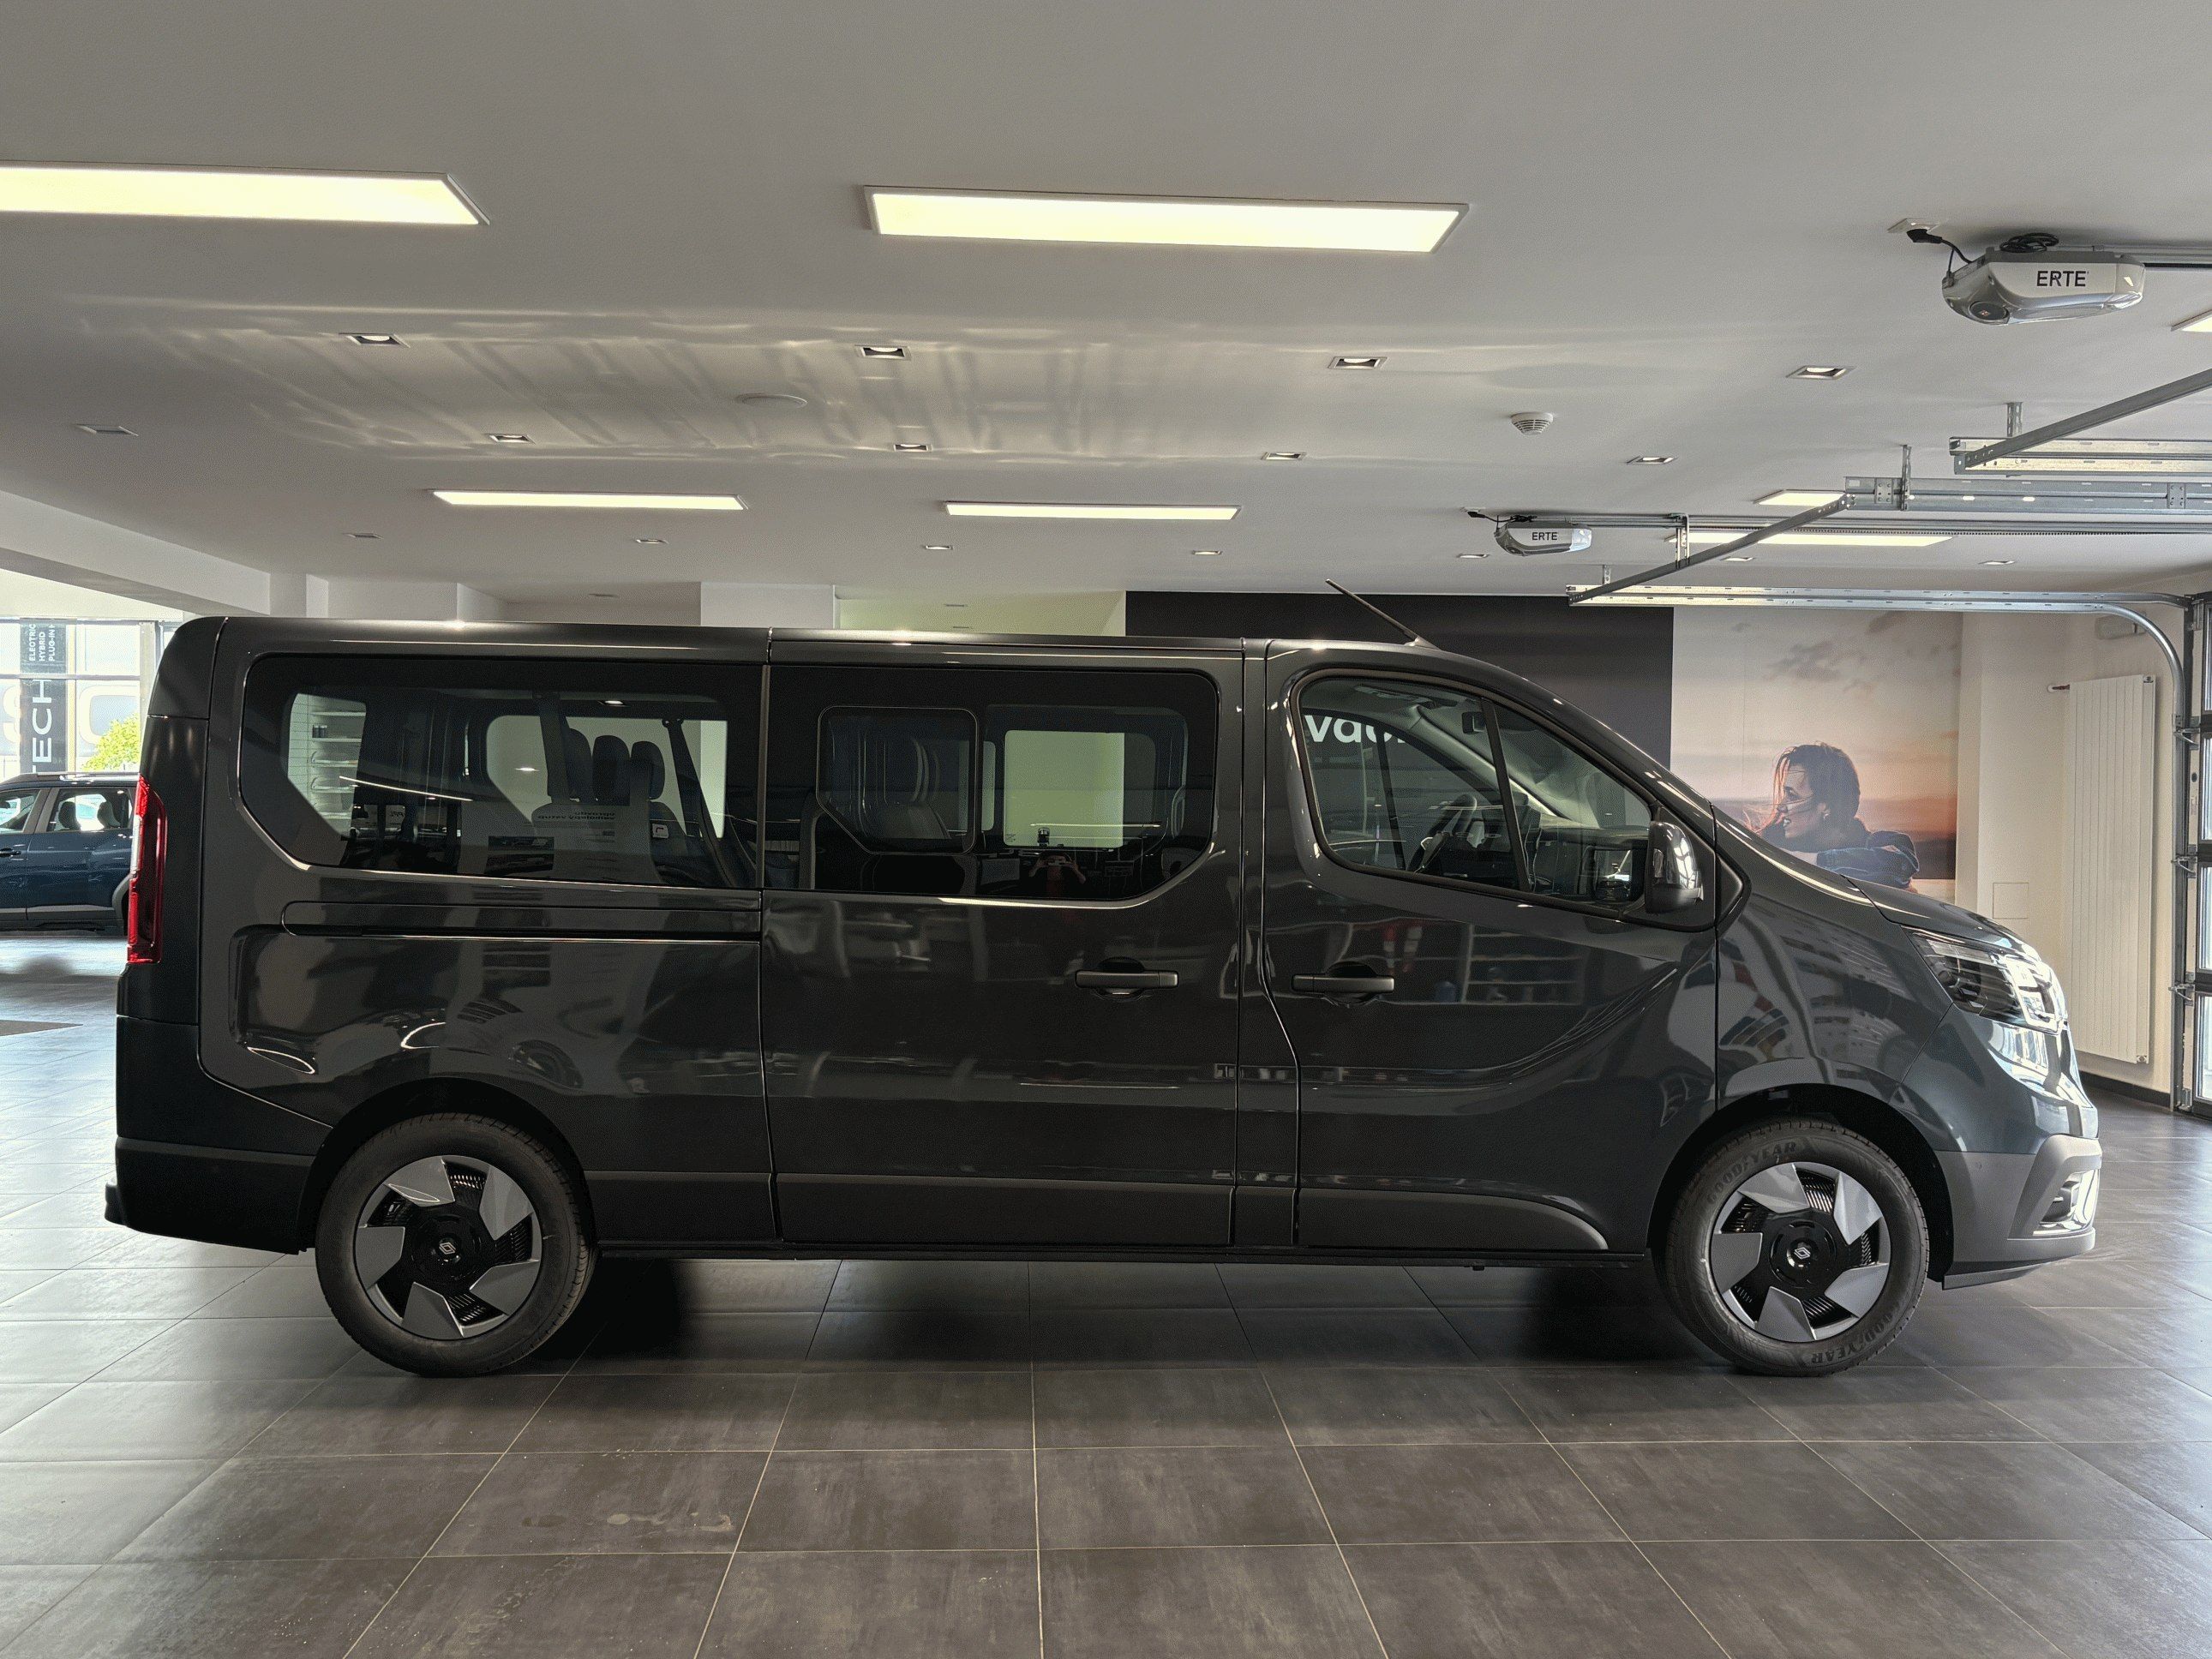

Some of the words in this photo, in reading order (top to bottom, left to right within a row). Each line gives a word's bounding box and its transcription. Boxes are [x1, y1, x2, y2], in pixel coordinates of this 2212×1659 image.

[2036, 270, 2087, 287] ERTE
[1532, 531, 1558, 541] ERTE
[32, 680, 52, 773] ECH
